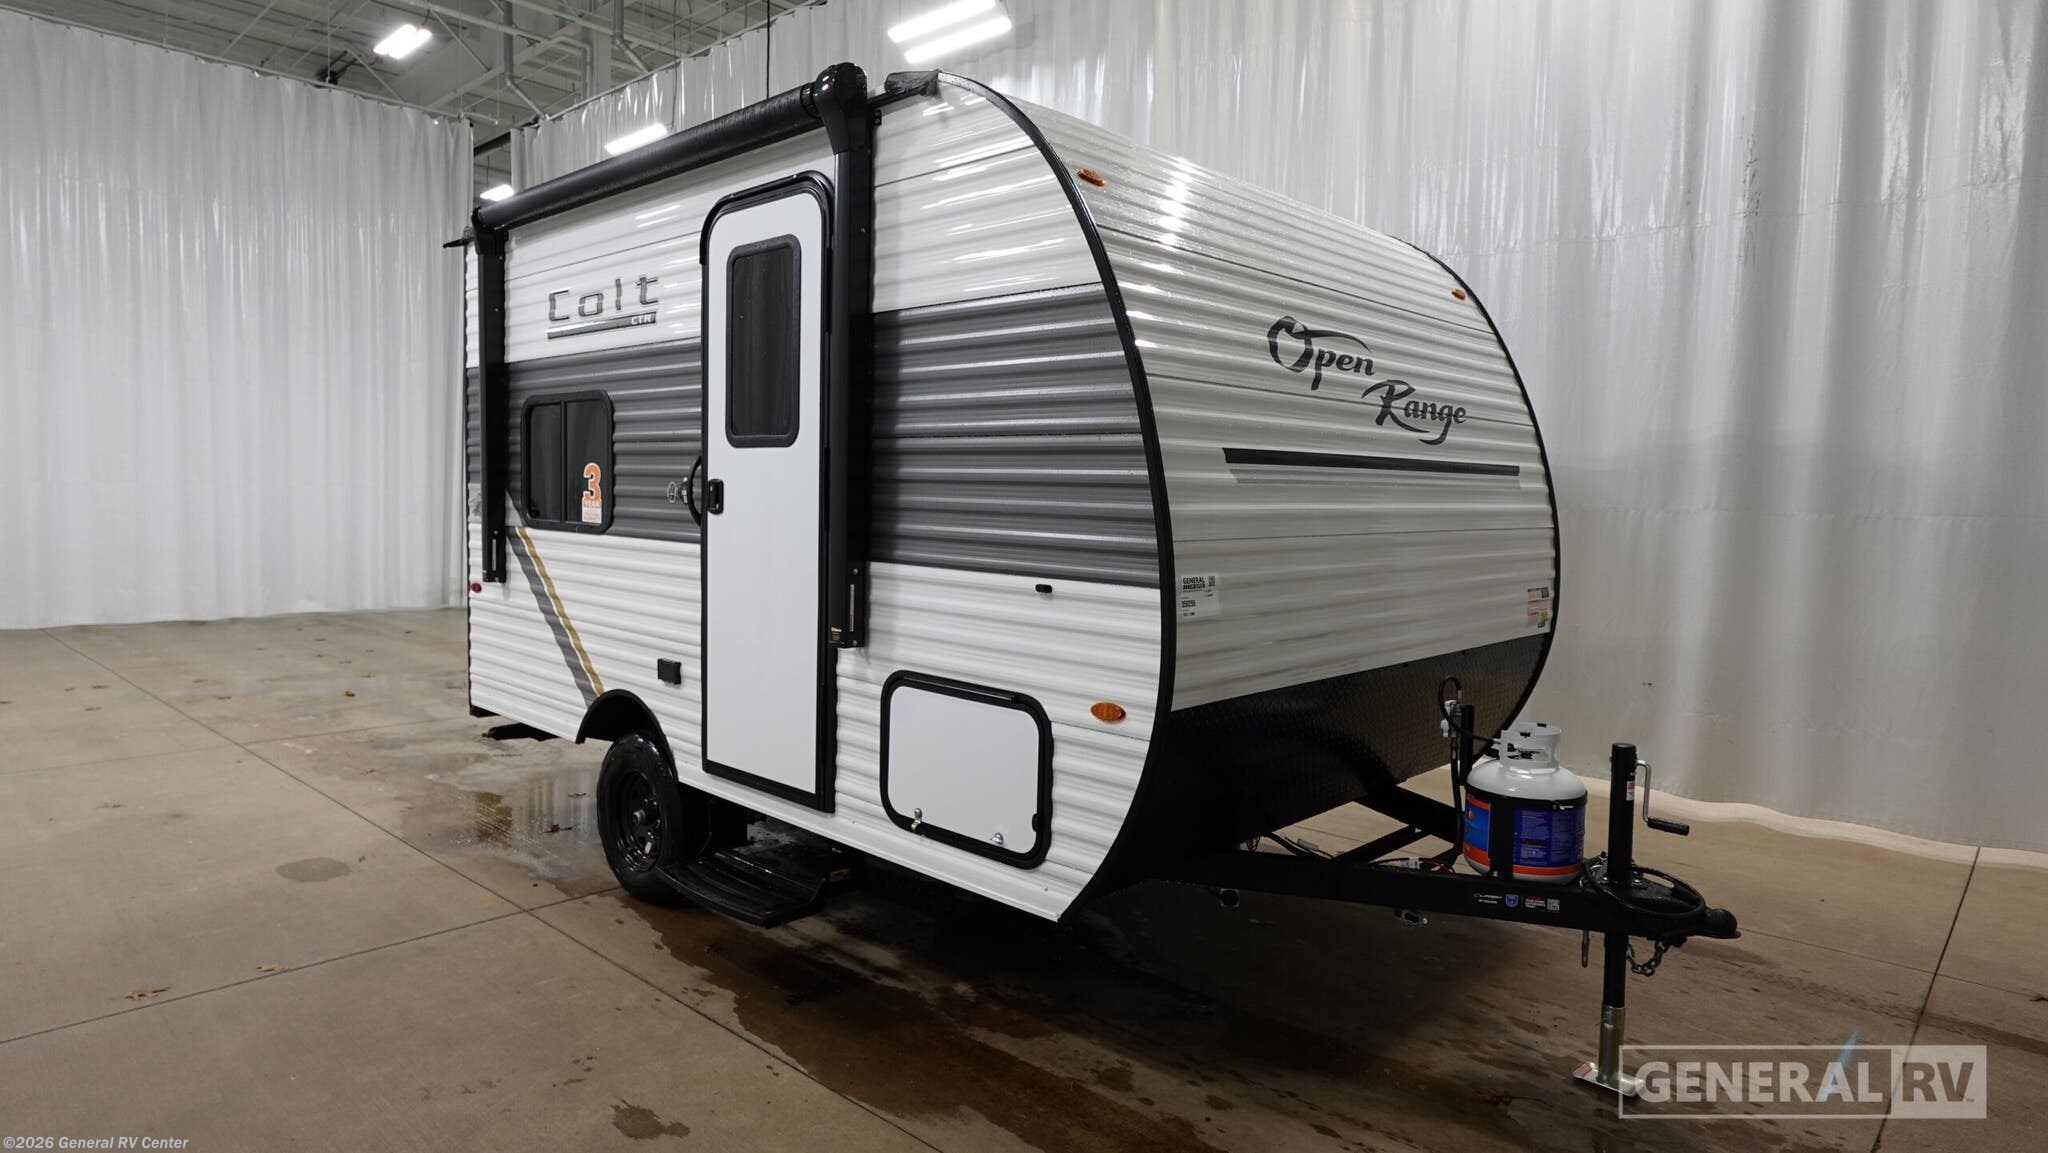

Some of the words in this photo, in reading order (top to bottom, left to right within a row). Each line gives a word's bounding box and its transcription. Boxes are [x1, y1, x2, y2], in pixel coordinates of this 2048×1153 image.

[548, 276, 659, 322] Colt
[631, 314, 652, 325] CTR
[1267, 315, 1375, 391] Open
[1361, 379, 1466, 445] Range
[583, 463, 601, 500] 3
